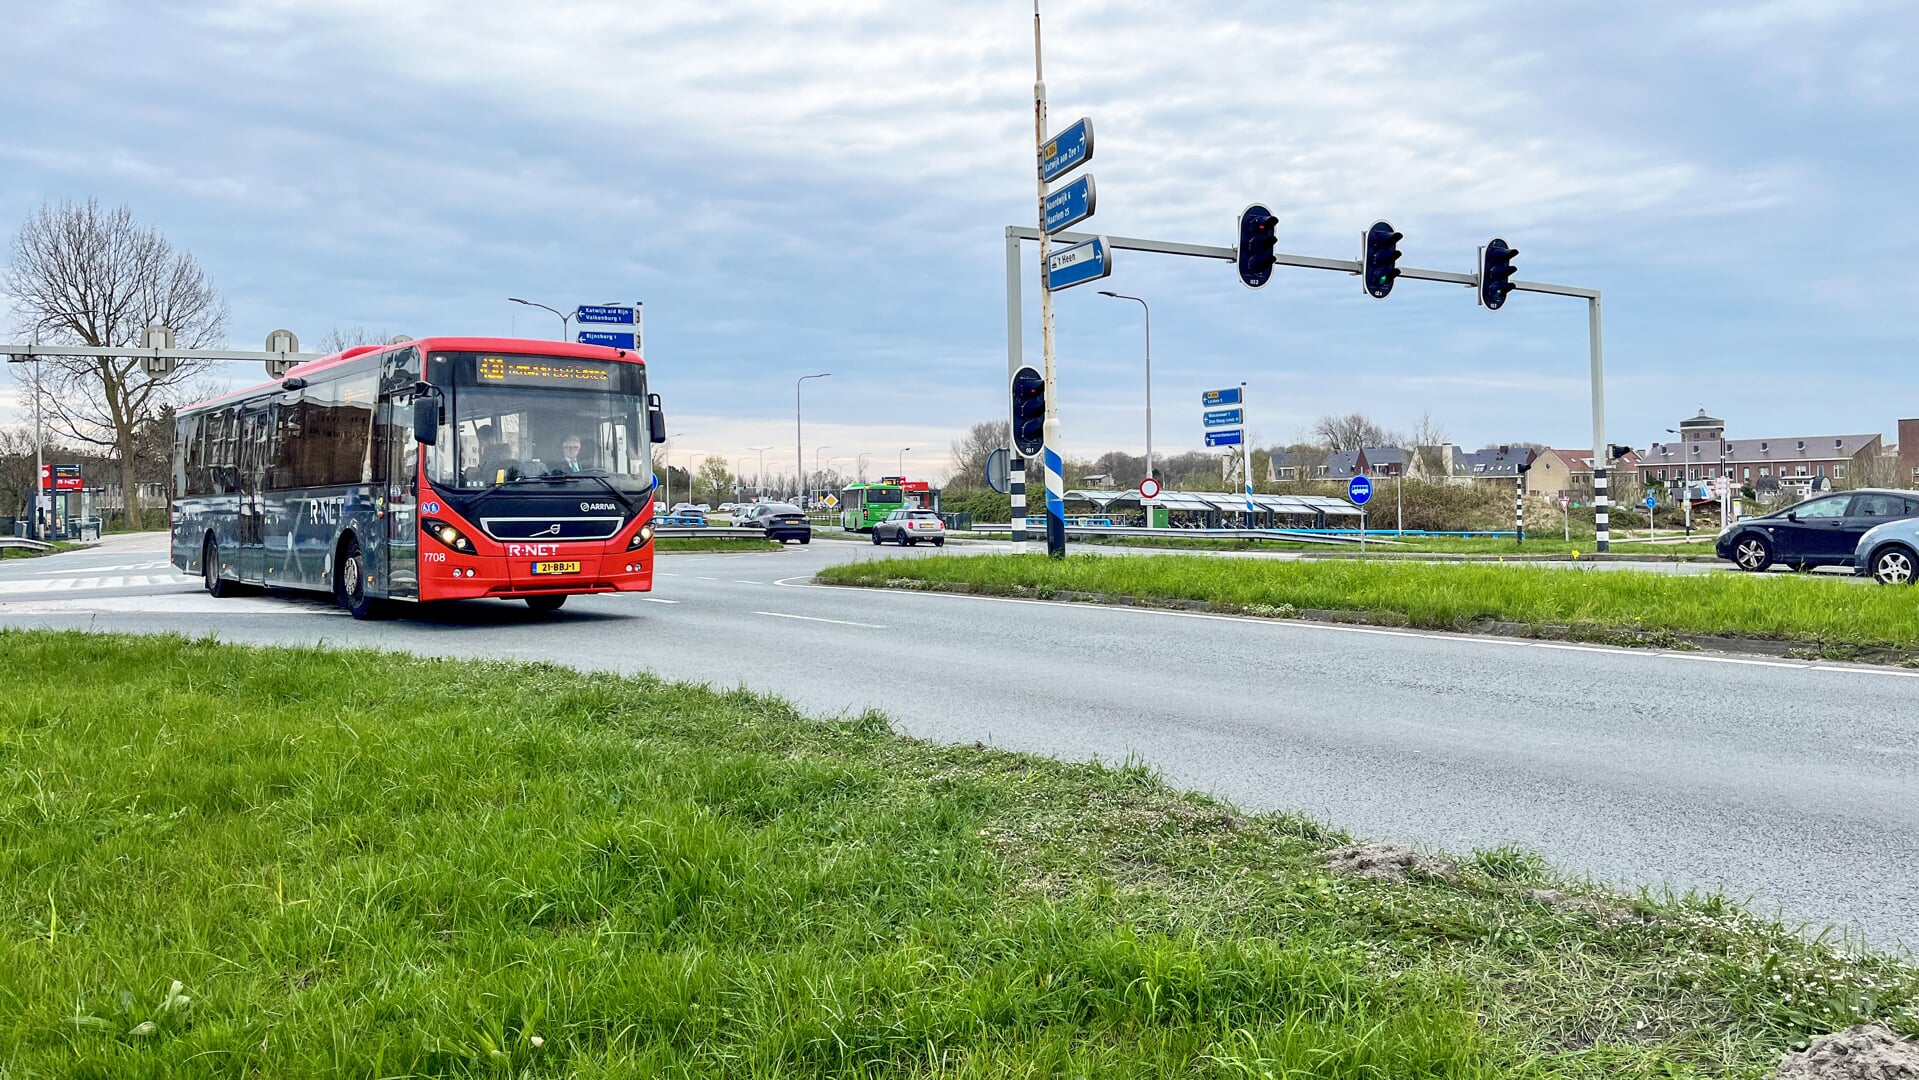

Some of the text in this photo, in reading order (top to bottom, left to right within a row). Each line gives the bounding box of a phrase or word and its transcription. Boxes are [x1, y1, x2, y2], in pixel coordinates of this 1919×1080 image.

[1045, 157, 1059, 172] Katwijk
[1060, 153, 1068, 163] aan
[1068, 147, 1077, 158] Zee
[1047, 192, 1068, 211] Noordwijk
[1047, 210, 1064, 225] Haarlem
[1062, 253, 1076, 263] Heen
[618, 308, 629, 316] Rijn
[424, 552, 446, 563] 7708
[542, 562, 575, 572] 21-BBJ-1
